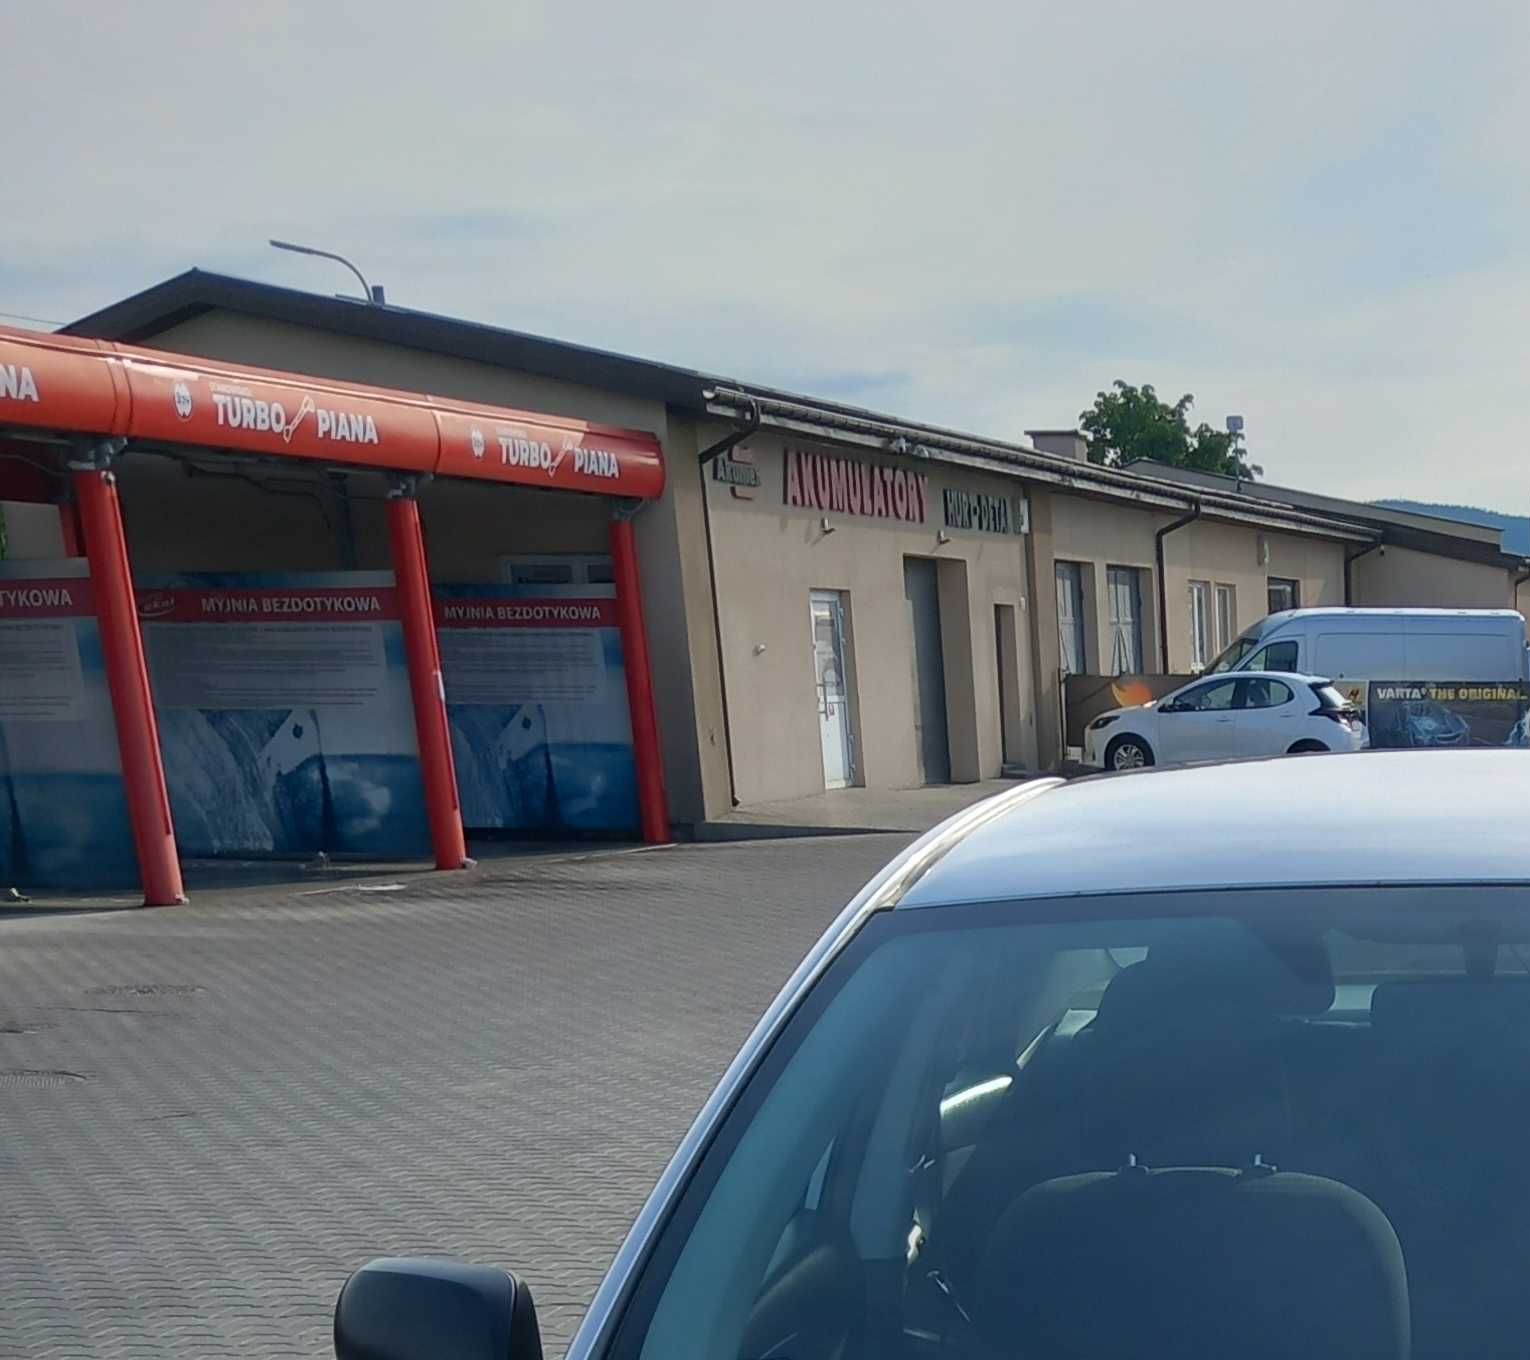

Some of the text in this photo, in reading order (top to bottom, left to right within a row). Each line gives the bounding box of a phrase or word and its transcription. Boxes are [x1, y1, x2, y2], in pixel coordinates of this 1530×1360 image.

[212, 393, 286, 434] TURBO
[317, 408, 378, 444] PIANA
[499, 437, 550, 468] TURBO
[574, 447, 620, 479] PIANA
[785, 451, 927, 523] AKUMULATORY
[202, 596, 380, 613] MYJNIA BEZDOTYKOWA
[445, 606, 601, 620] MYJNIA BEZDOTYKOWA
[1430, 688, 1455, 700] THE
